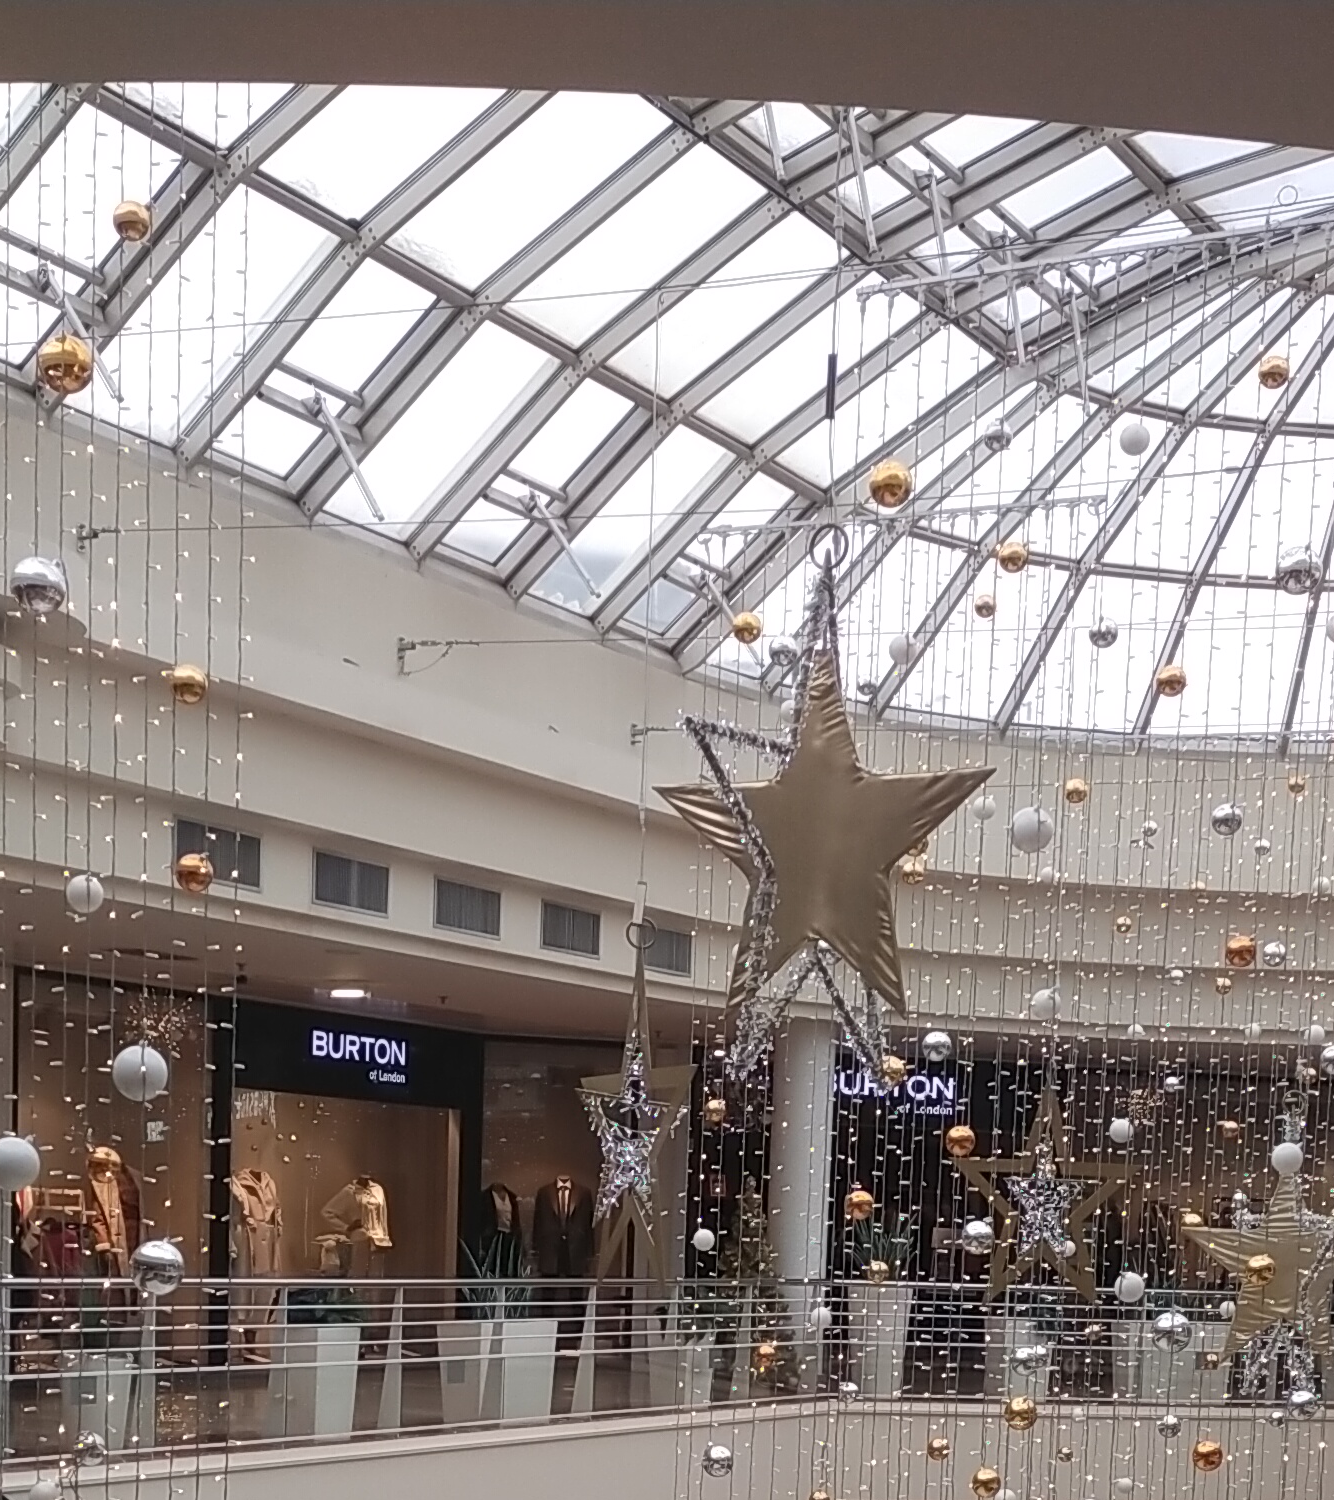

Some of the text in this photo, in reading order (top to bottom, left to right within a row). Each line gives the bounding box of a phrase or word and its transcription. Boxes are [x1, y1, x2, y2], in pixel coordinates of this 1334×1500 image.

[312, 1029, 406, 1066] BURTON
[369, 1069, 406, 1083] of London
[914, 1104, 953, 1116] London
